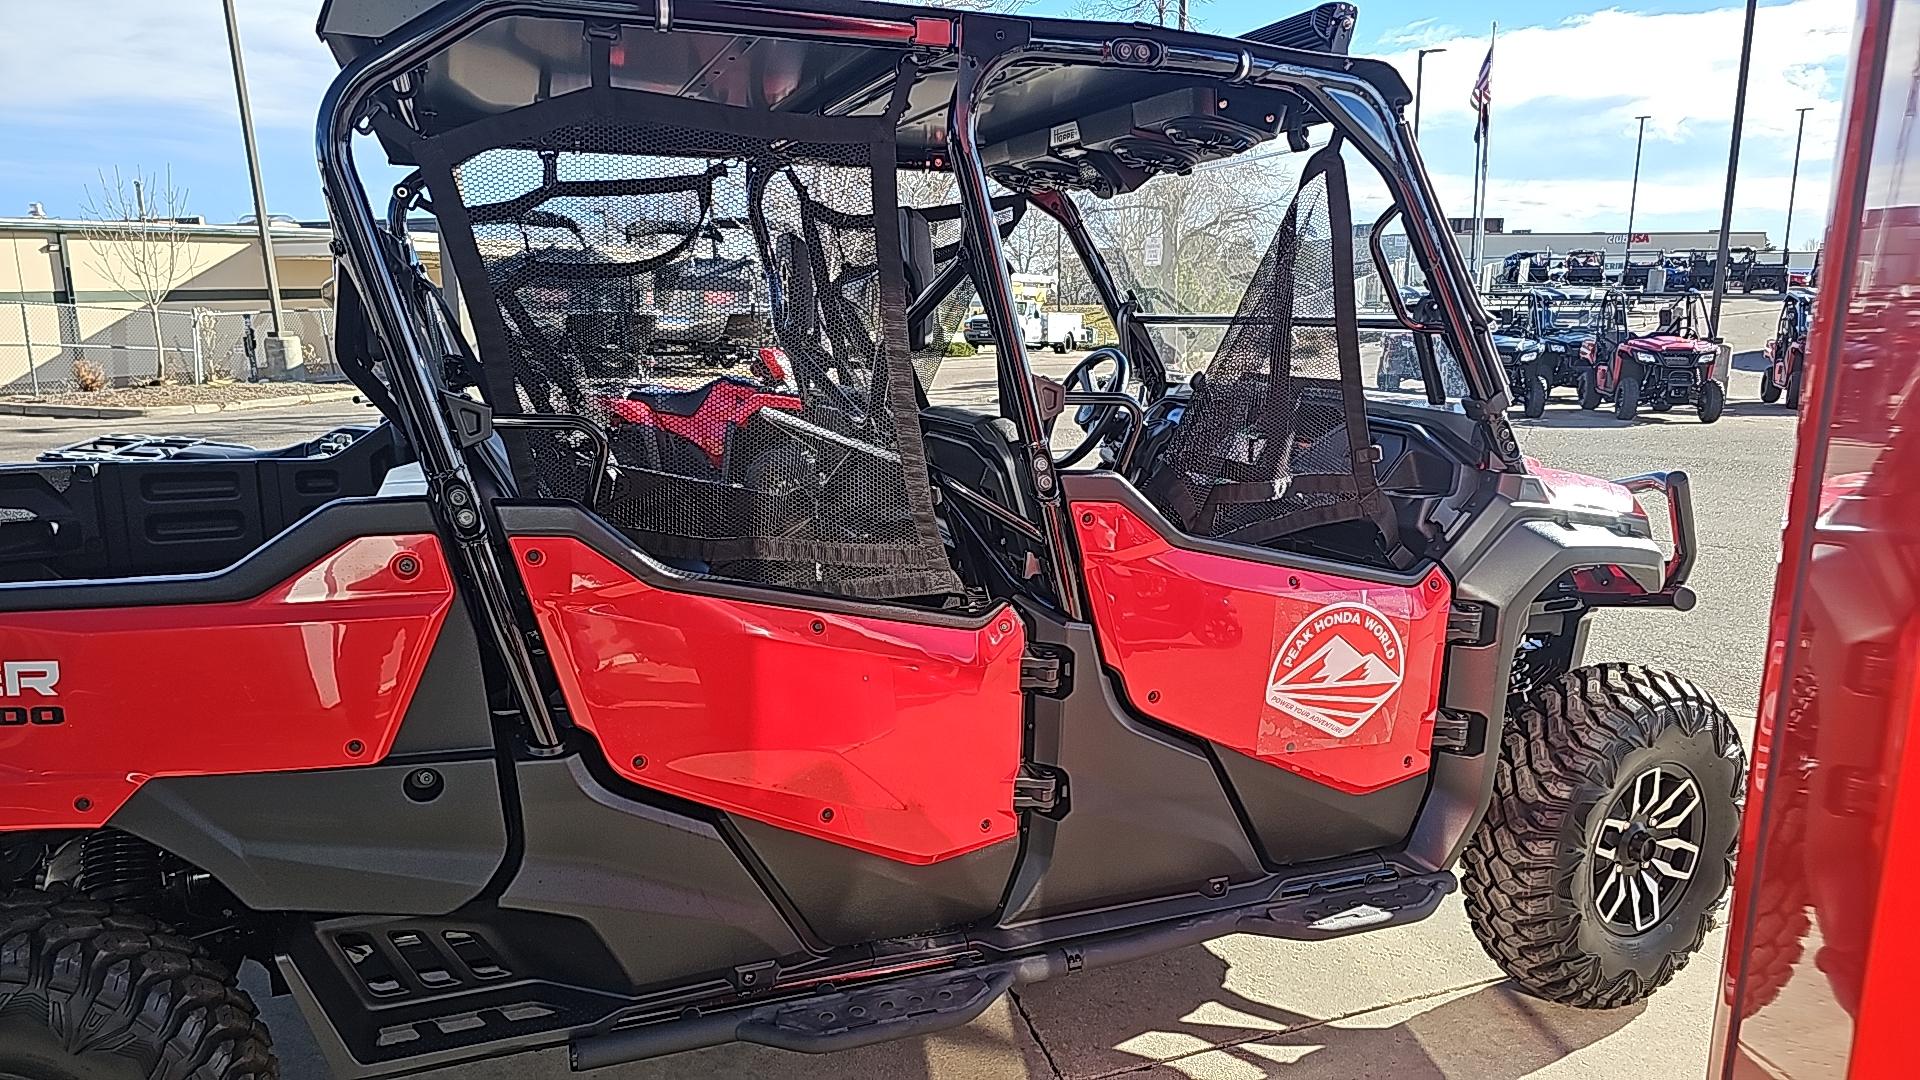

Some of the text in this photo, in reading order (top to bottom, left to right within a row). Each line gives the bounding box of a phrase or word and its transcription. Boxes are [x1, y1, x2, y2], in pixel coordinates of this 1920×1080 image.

[1282, 611, 1396, 668] PEAK HONDA WORLD
[0, 660, 60, 697] R
[1270, 695, 1345, 734] POWER YOUR ADVENTURE
